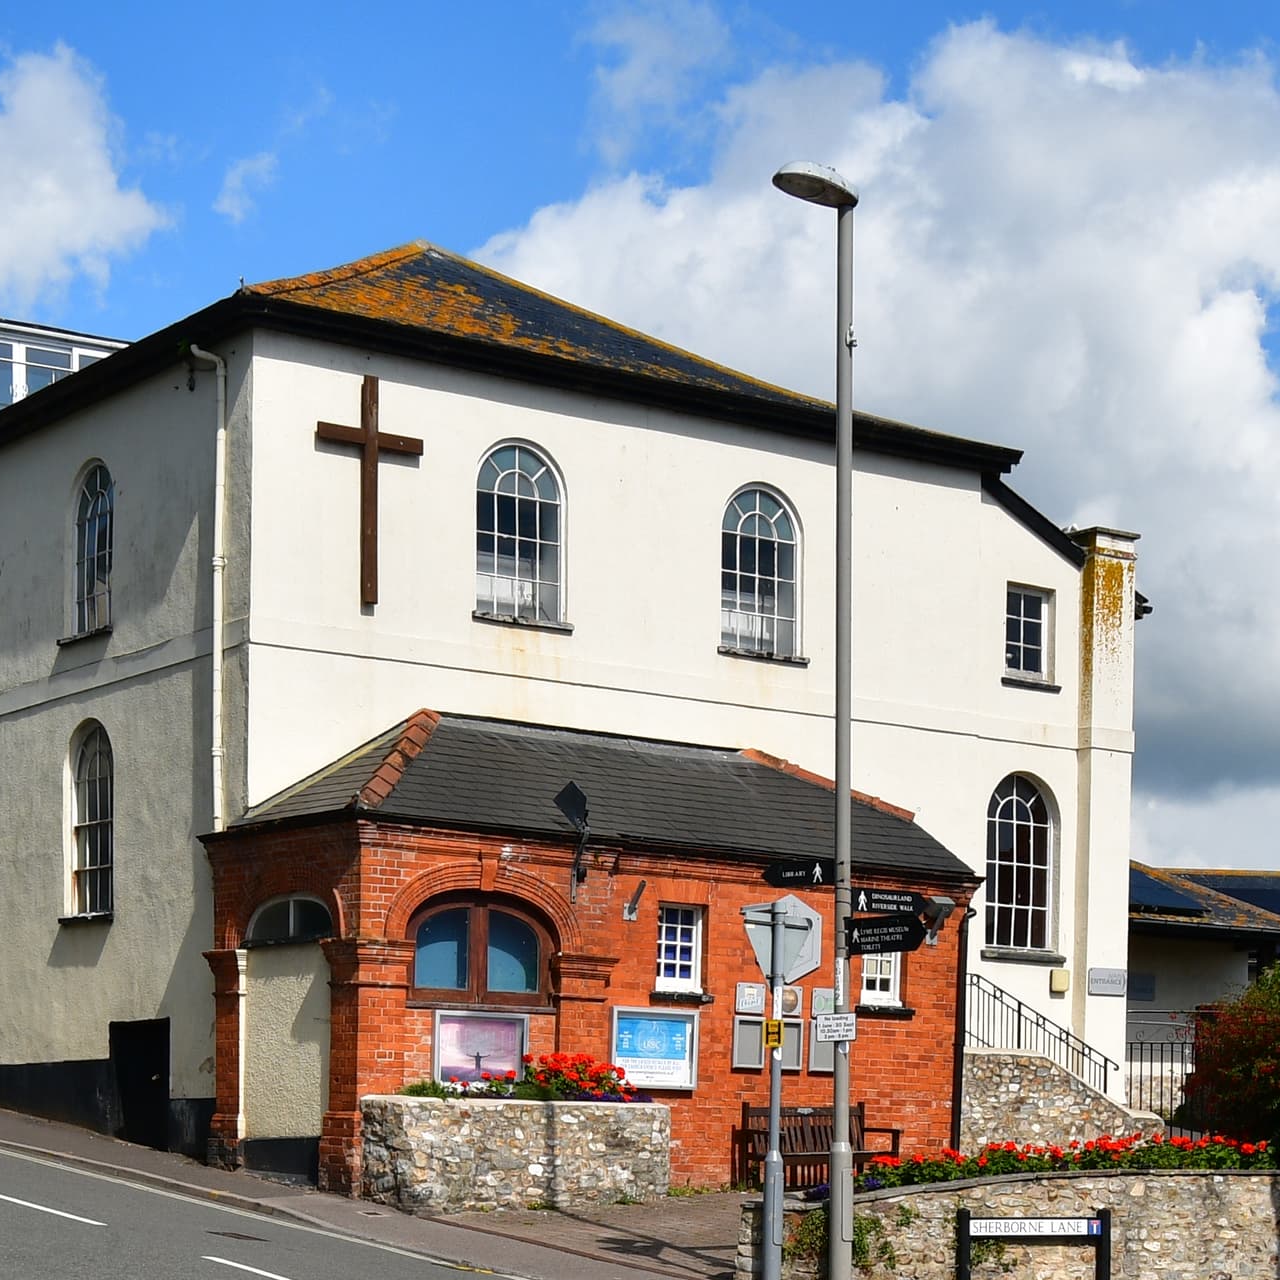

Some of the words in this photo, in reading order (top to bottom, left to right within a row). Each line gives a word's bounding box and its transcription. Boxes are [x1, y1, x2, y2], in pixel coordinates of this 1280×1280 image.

[871, 903, 898, 911] RIVERSIDE
[1091, 977, 1121, 985] ENTRANCE
[972, 1221, 1044, 1234] SHERBORNE
[1051, 1221, 1083, 1233] LANE
